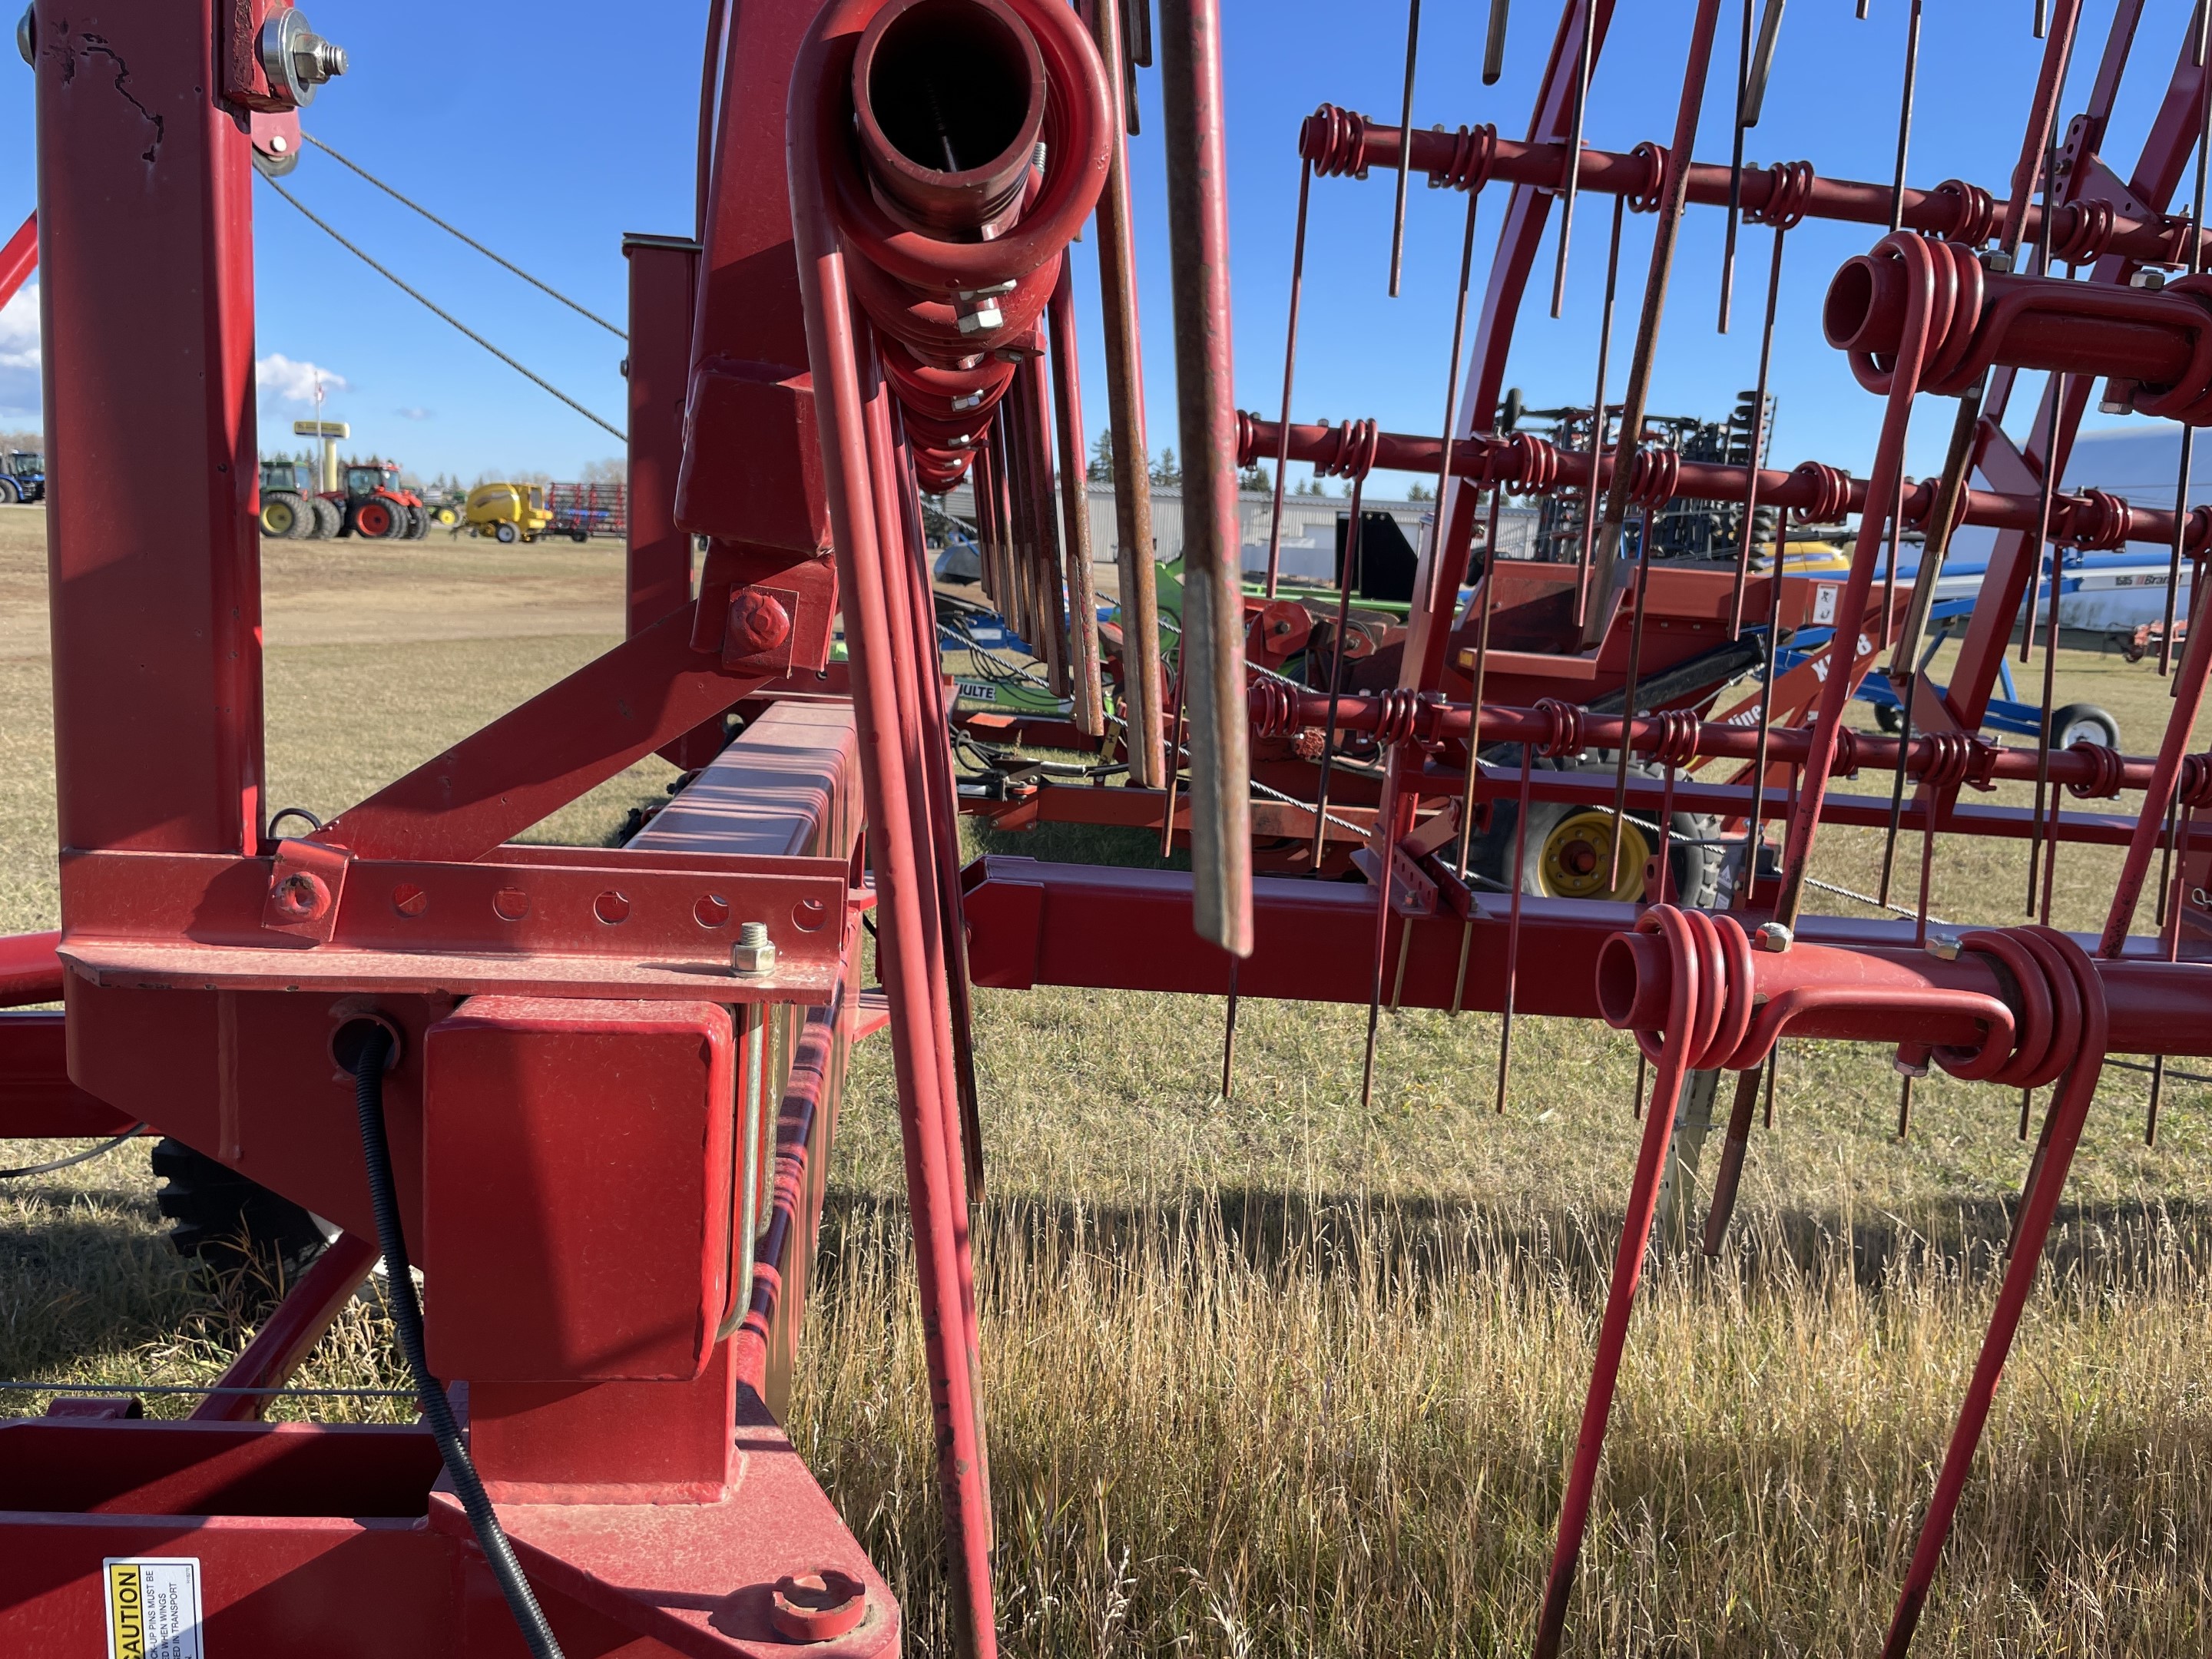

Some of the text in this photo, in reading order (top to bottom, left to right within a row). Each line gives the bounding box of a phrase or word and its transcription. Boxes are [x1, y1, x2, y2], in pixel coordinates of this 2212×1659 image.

[146, 1571, 154, 1581] BE
[146, 1584, 155, 1608] MUST
[158, 1593, 167, 1621] WINGS
[169, 1582, 180, 1633] TRANSPORT
[160, 1624, 169, 1649] WHEN
